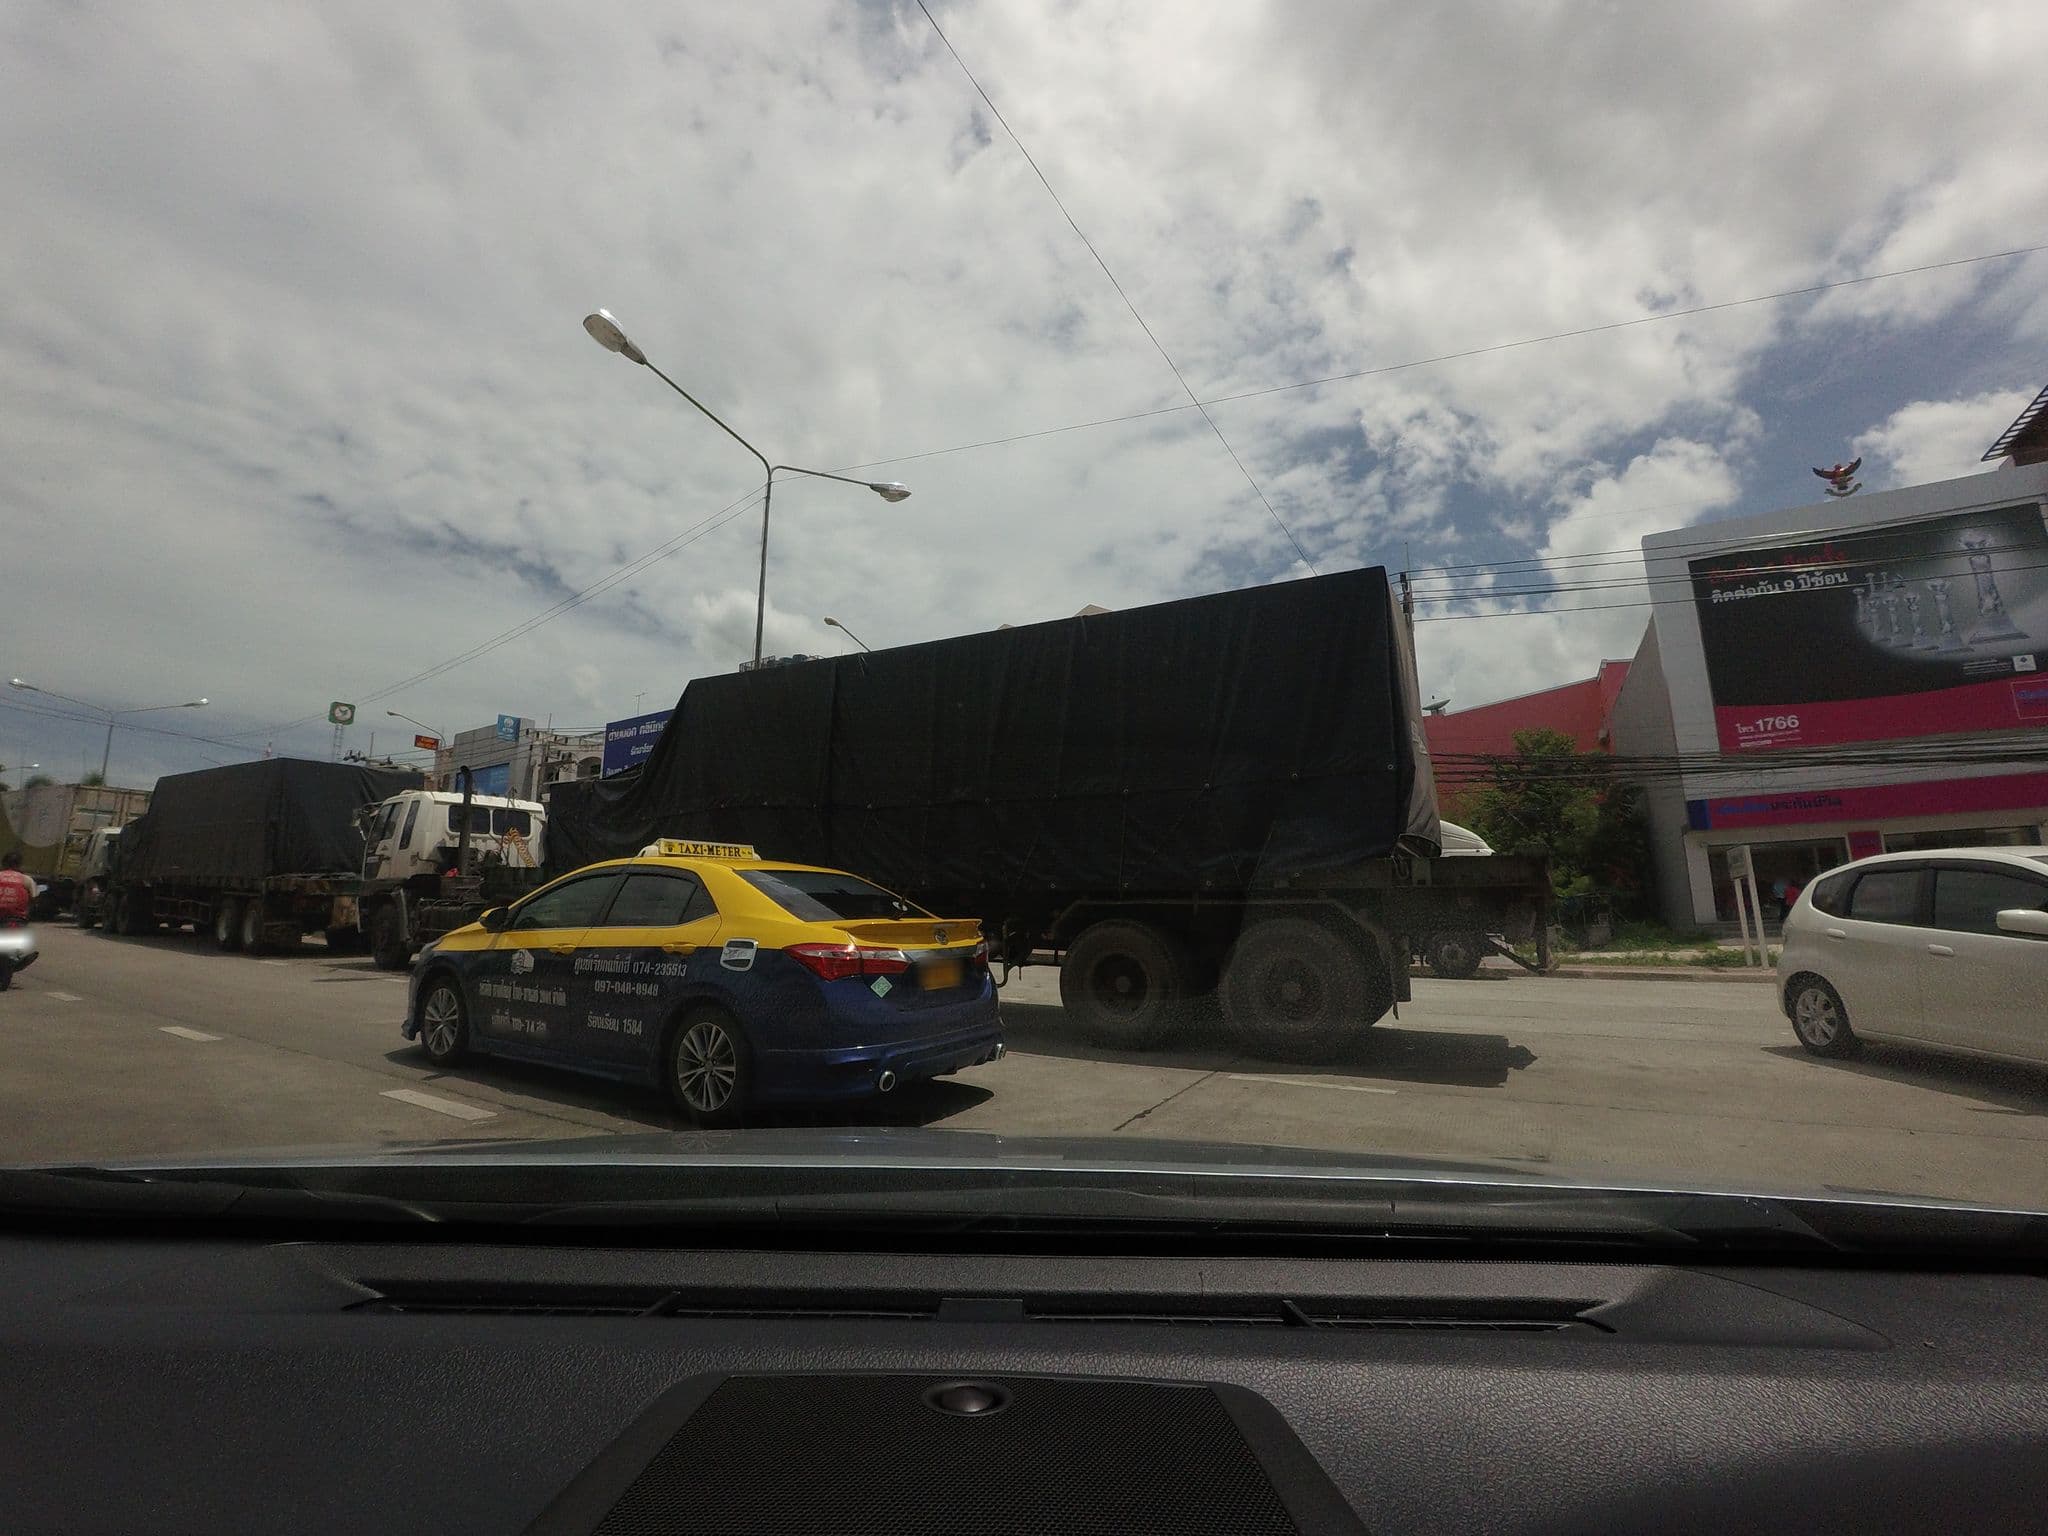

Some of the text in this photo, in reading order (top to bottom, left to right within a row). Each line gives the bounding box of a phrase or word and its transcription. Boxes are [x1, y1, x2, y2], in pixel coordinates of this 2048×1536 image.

[1783, 579, 1796, 593] 9
[1755, 714, 1800, 732] 1766
[632, 961, 688, 977] 074-235513
[622, 1018, 643, 1036] 1584
